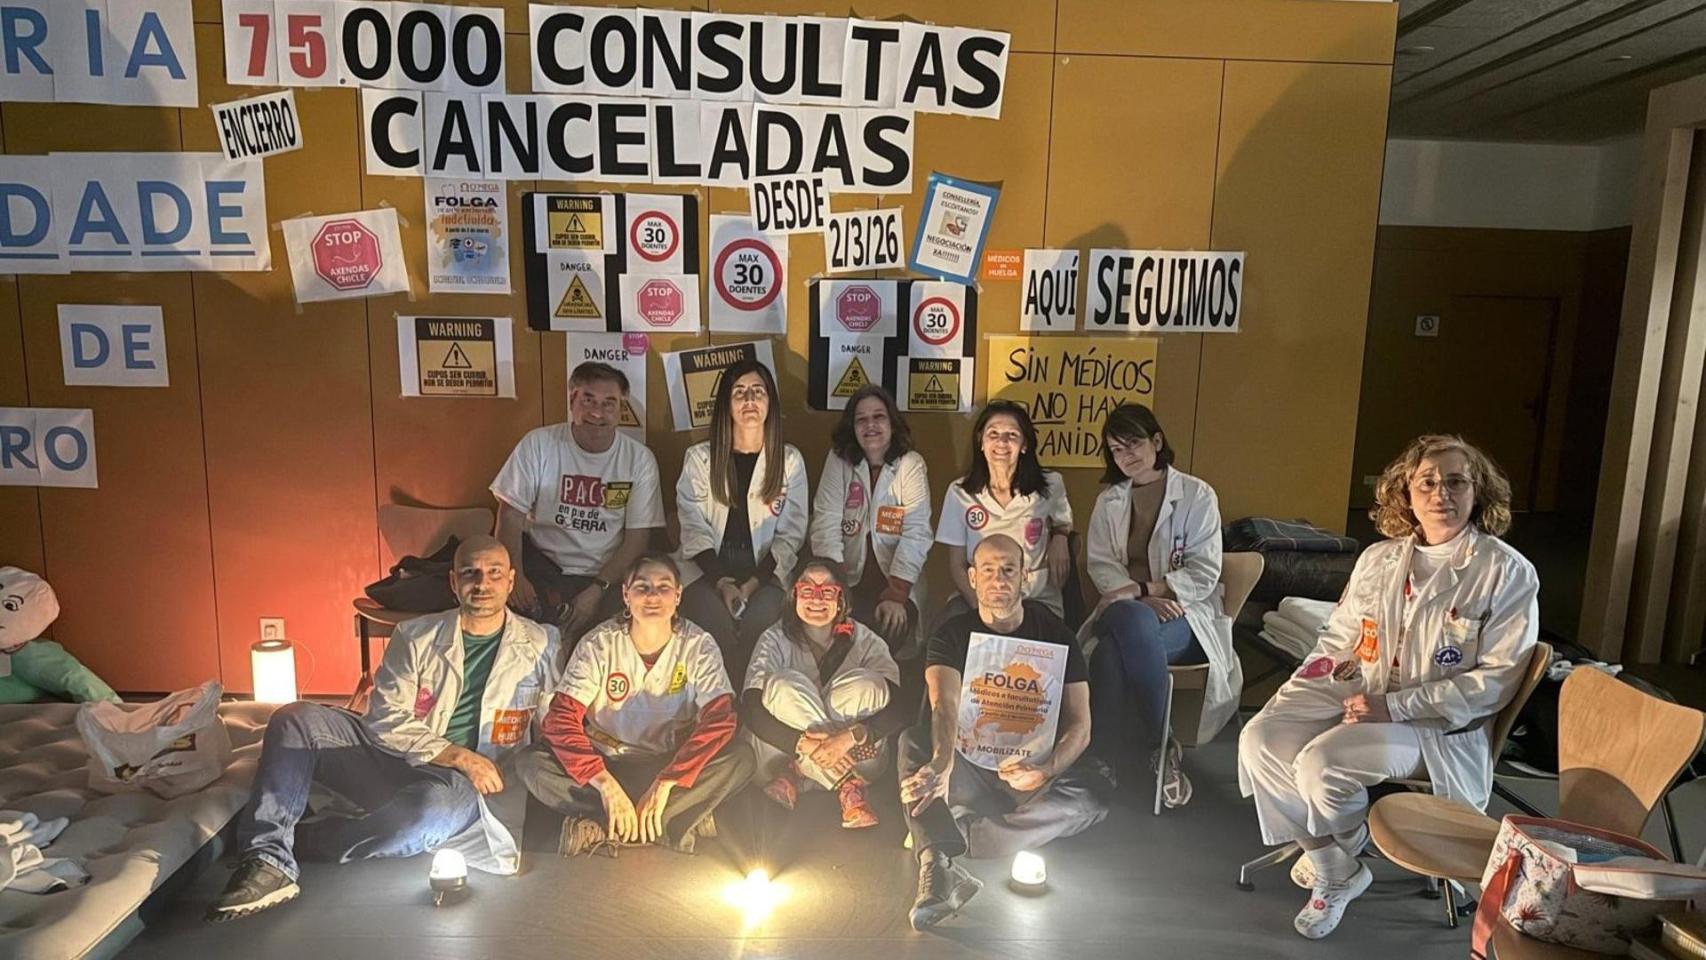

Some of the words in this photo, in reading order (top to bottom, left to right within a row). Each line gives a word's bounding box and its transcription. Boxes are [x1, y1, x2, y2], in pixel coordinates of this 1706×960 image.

[2, 7, 186, 80] RIA
[239, 7, 502, 87] 75.000
[537, 13, 1005, 108] CONSULTAS
[219, 97, 296, 160] ENCIERRO
[370, 97, 910, 187] CANCELADAS
[435, 197, 498, 207] FOLGA
[556, 200, 594, 210] WARNING
[754, 178, 824, 231] DESDE
[0, 181, 249, 247] DADE
[325, 231, 361, 246] STOP
[644, 228, 665, 243] 30
[829, 214, 898, 267] 2/3/26
[739, 254, 759, 262] MAX
[330, 264, 369, 276] AXENDAS
[560, 262, 592, 271] DANGER
[336, 274, 365, 284] CHICLE
[733, 264, 763, 285] 30
[647, 288, 673, 296] STOP
[729, 285, 766, 294] DOENTES
[1025, 256, 1078, 318] AQUÍ
[1094, 255, 1240, 327] SEGUIMOS
[847, 293, 871, 302] STOP
[927, 313, 946, 328] 30
[428, 322, 482, 337] WARNING
[70, 323, 156, 369] DE
[841, 344, 871, 354] DANGER
[584, 348, 629, 361] DANGER
[693, 349, 744, 368] WARNING
[919, 361, 953, 371] WARNING
[1032, 392, 1068, 420] NO
[1077, 394, 1128, 423] HAY
[1, 426, 87, 471] RO
[1033, 427, 1104, 457] ANID
[558, 505, 570, 514] en
[588, 509, 599, 519] de
[969, 511, 983, 523] 30
[610, 679, 626, 693] 30
[984, 672, 1038, 693] FOLGA
